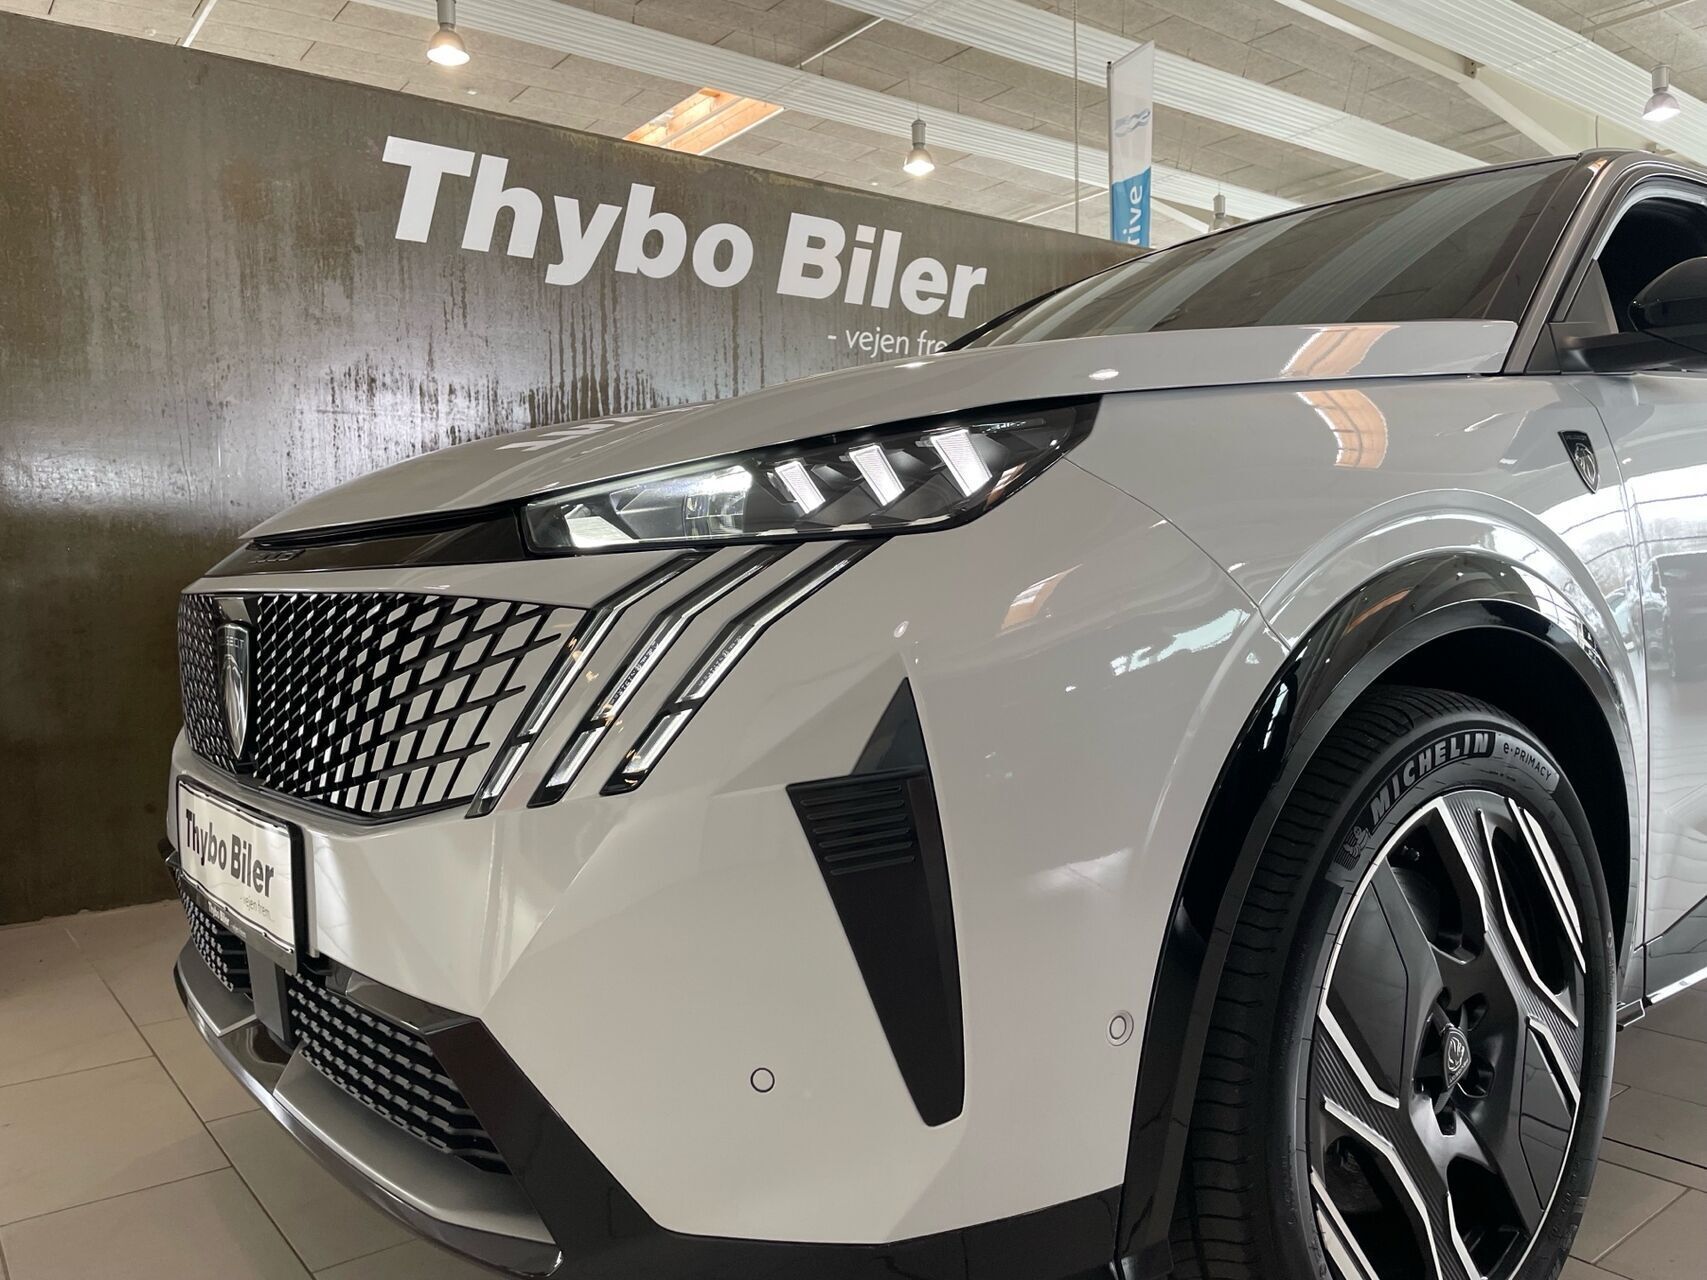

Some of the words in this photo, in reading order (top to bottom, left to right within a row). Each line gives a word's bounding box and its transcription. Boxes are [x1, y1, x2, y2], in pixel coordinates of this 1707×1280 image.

[381, 135, 754, 289] Thybo
[776, 211, 988, 320] Biler
[1122, 185, 1143, 246] rive
[845, 326, 910, 359] vejen
[916, 329, 949, 356] fre
[1369, 732, 1490, 826] MICHELIN
[185, 808, 227, 872] Thybo
[230, 834, 275, 898] Biler
